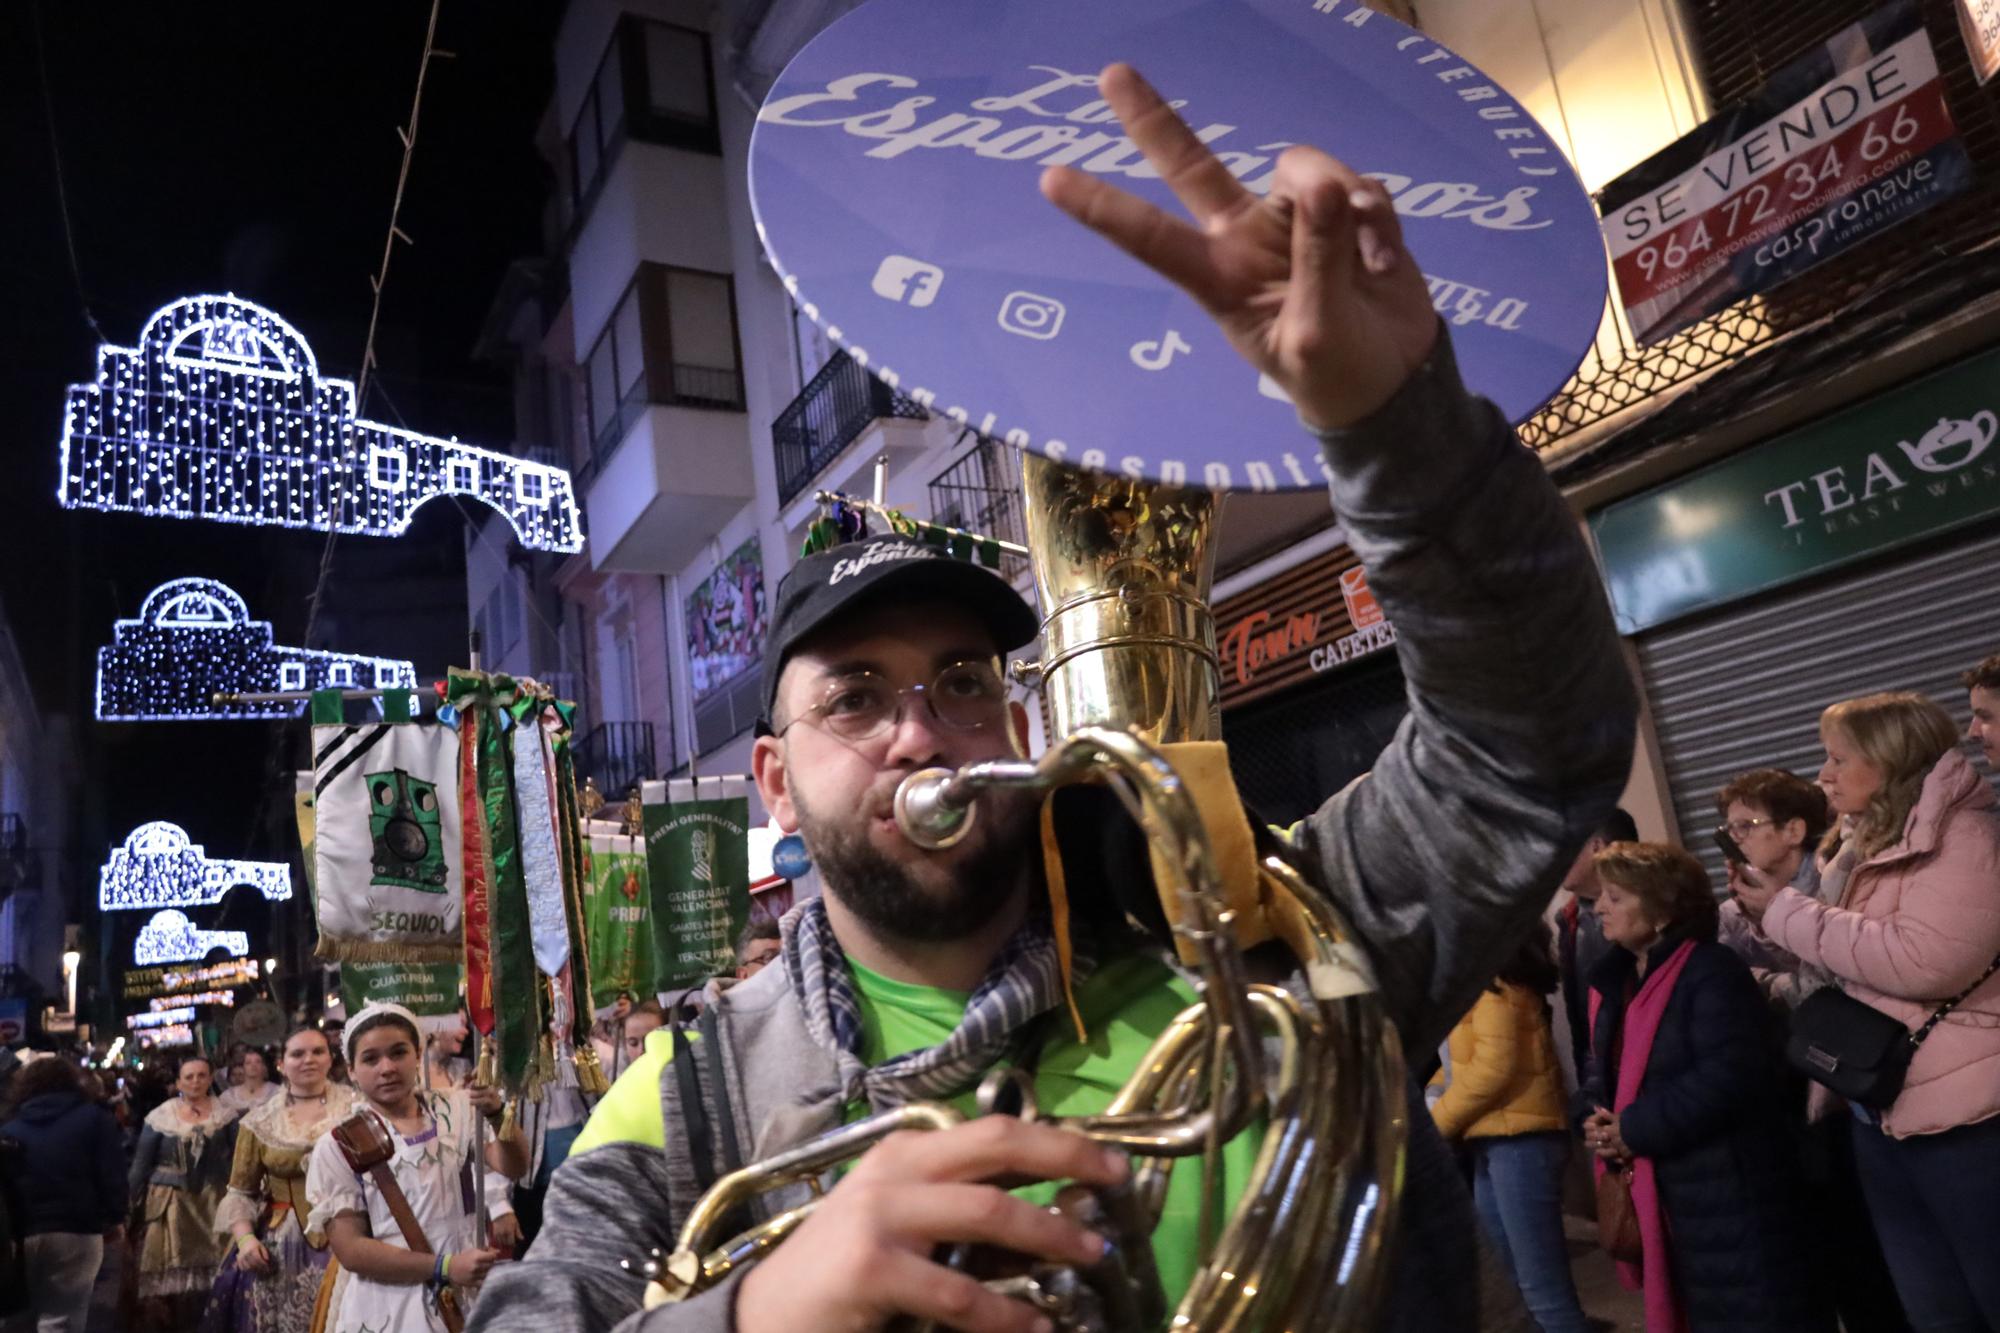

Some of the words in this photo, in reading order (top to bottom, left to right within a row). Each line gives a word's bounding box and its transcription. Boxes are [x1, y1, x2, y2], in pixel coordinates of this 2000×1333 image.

[971, 65, 1188, 125] Lo
[1396, 36, 1557, 176] (TERUEL)
[1623, 184, 1687, 241] SE
[1703, 54, 1906, 192] VENDE
[1636, 222, 1712, 281] 964
[1721, 186, 1776, 237] 72
[1785, 145, 1843, 201] 34
[1860, 104, 1918, 161] 66
[1654, 150, 1912, 292] www.caspronaveinmobiliaria.com
[1754, 158, 1933, 267] caspronave
[1834, 181, 1940, 243] inmobiliaria
[1764, 453, 1907, 528] TEA
[862, 540, 908, 557] Los
[1221, 611, 1321, 685] Town
[649, 819, 679, 845] PREMI
[679, 812, 744, 836] GENERALITAT
[370, 912, 447, 935] SEQUIOL
[668, 886, 732, 902] GENERALITAT
[369, 973, 408, 989] QUART
